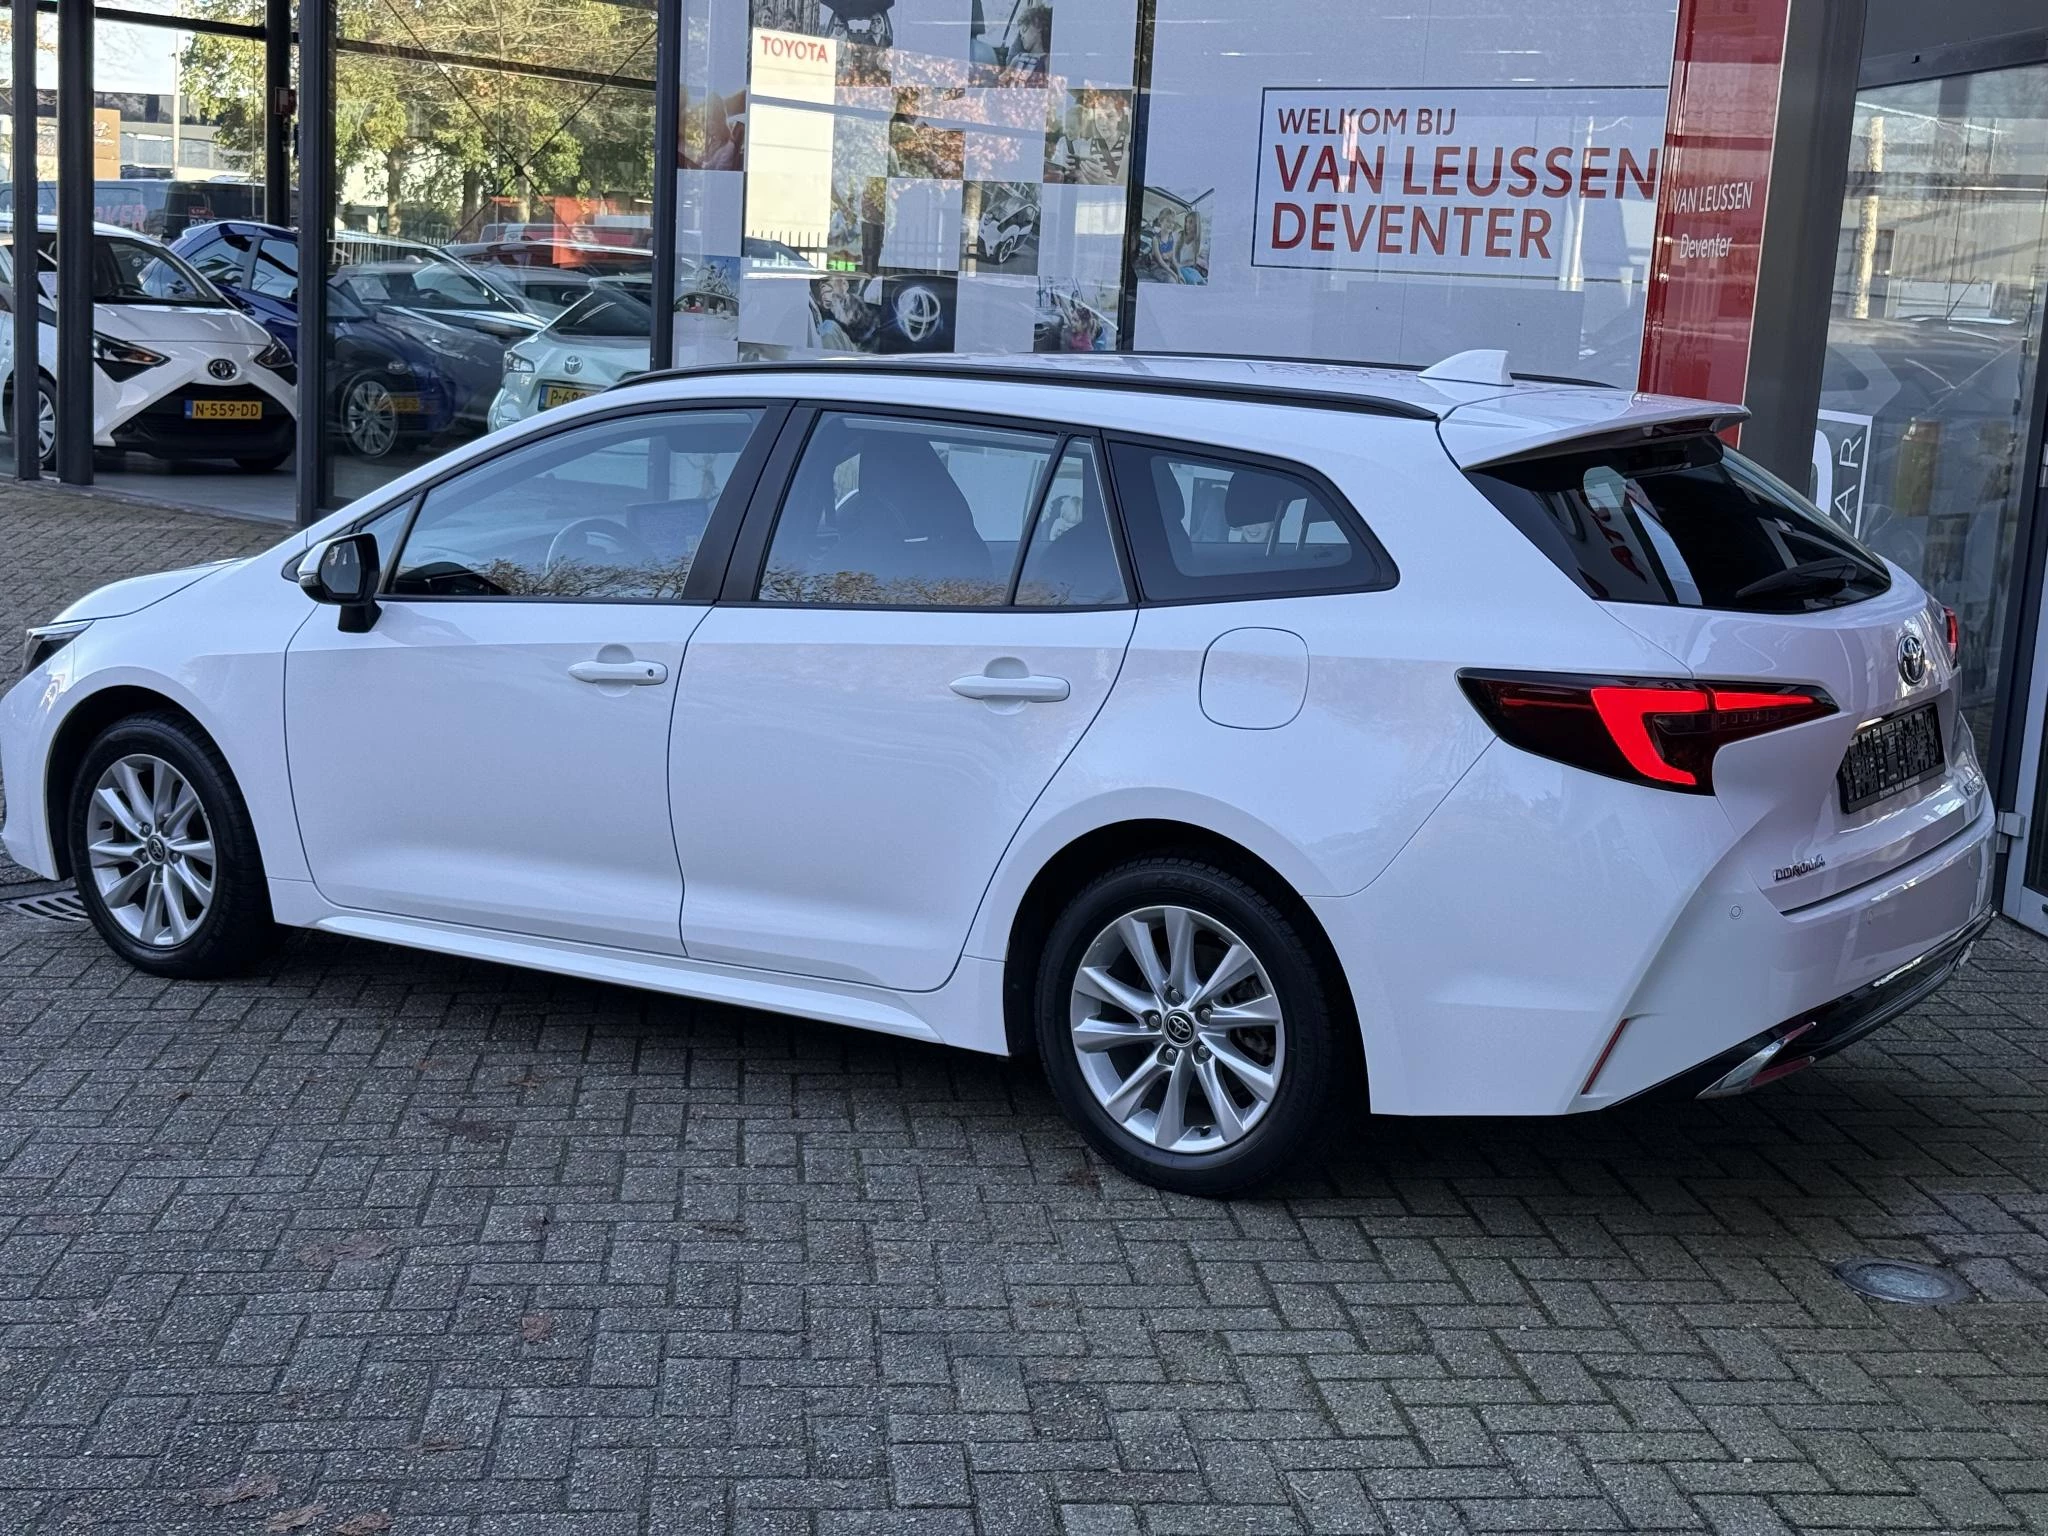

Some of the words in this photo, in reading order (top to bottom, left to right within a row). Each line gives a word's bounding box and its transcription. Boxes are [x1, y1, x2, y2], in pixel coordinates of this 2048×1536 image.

[760, 36, 828, 63] TOYOTA
[1277, 107, 1407, 136] WELKOM
[1416, 109, 1456, 136] BIJ
[1275, 144, 1386, 195] VAN
[1402, 146, 1659, 200] LEUSSEN
[1673, 187, 1698, 214] VAN
[1698, 181, 1754, 212] LEUSSEN
[1271, 202, 1553, 260] DEVENTER
[1679, 232, 1733, 259] Deventer
[195, 403, 259, 417] N-559-DD
